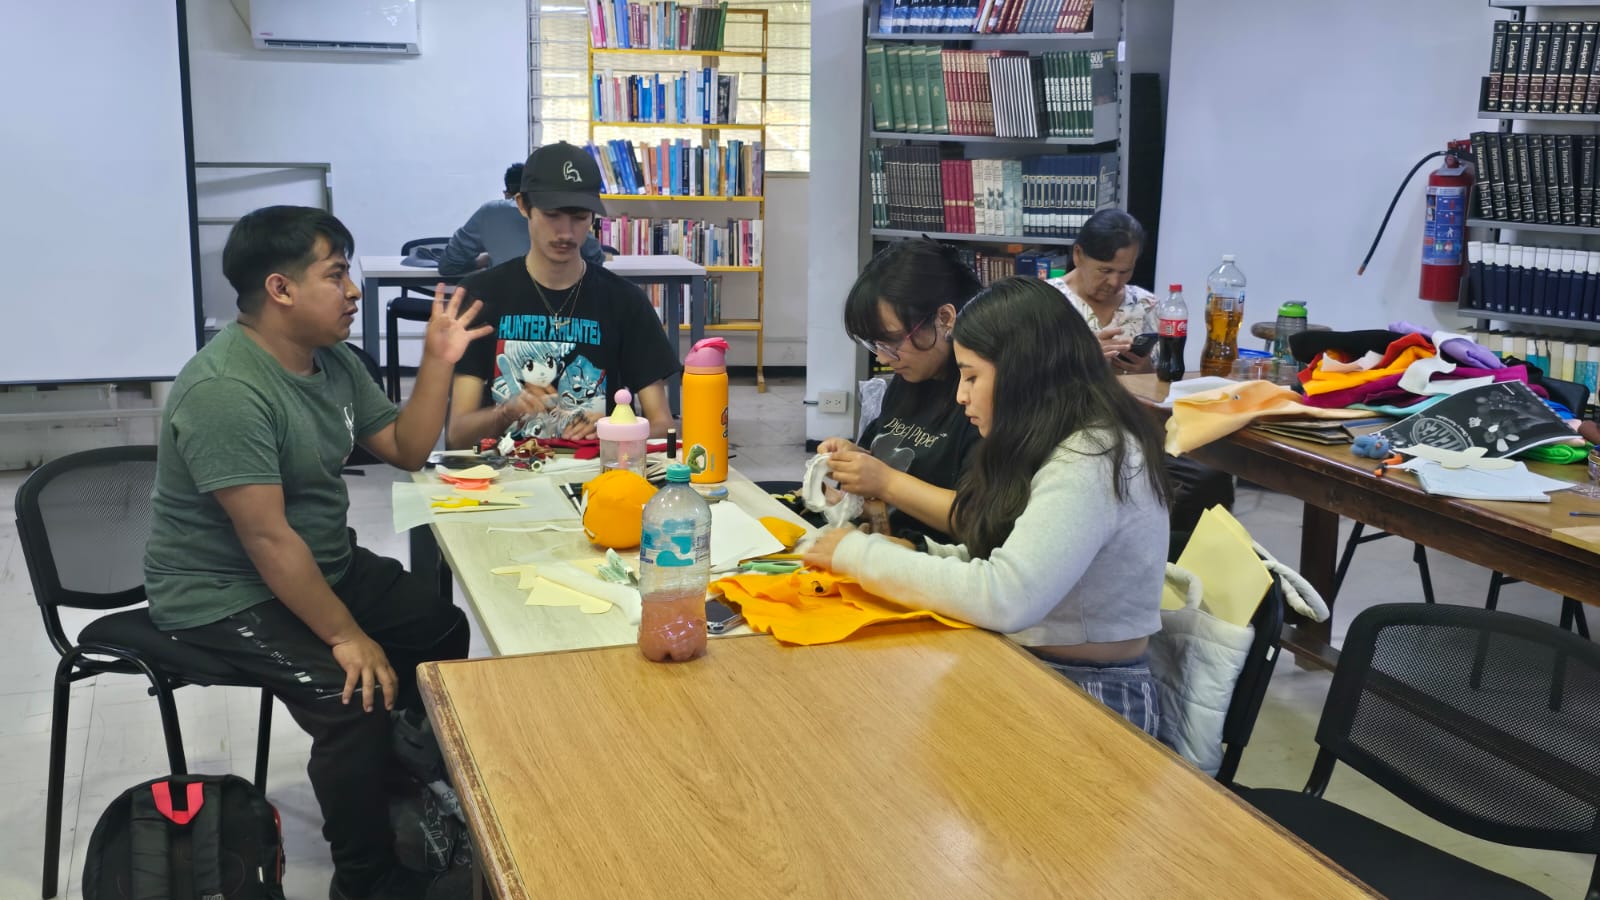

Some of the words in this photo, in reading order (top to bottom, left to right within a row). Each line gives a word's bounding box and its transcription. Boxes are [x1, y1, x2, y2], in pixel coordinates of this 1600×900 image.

[498, 314, 547, 340] HUNTER
[549, 316, 560, 340] X
[884, 417, 915, 437] Pied
